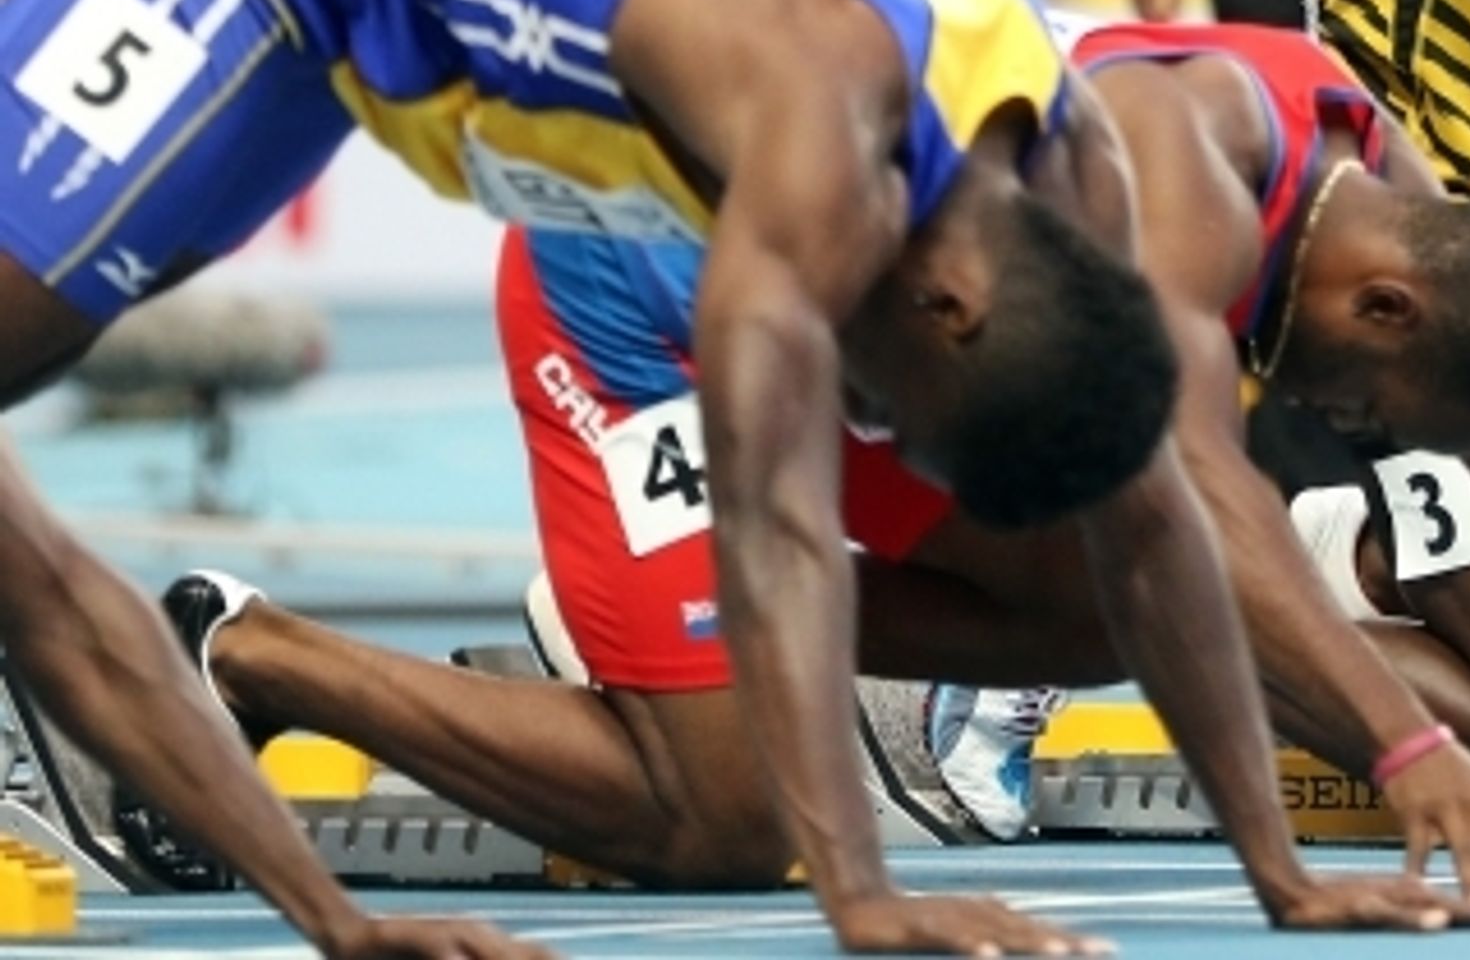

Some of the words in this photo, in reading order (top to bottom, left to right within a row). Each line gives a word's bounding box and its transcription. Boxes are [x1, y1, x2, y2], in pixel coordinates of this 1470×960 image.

[72, 27, 153, 109] 5
[643, 423, 706, 508] 4
[1405, 471, 1458, 558] 3
